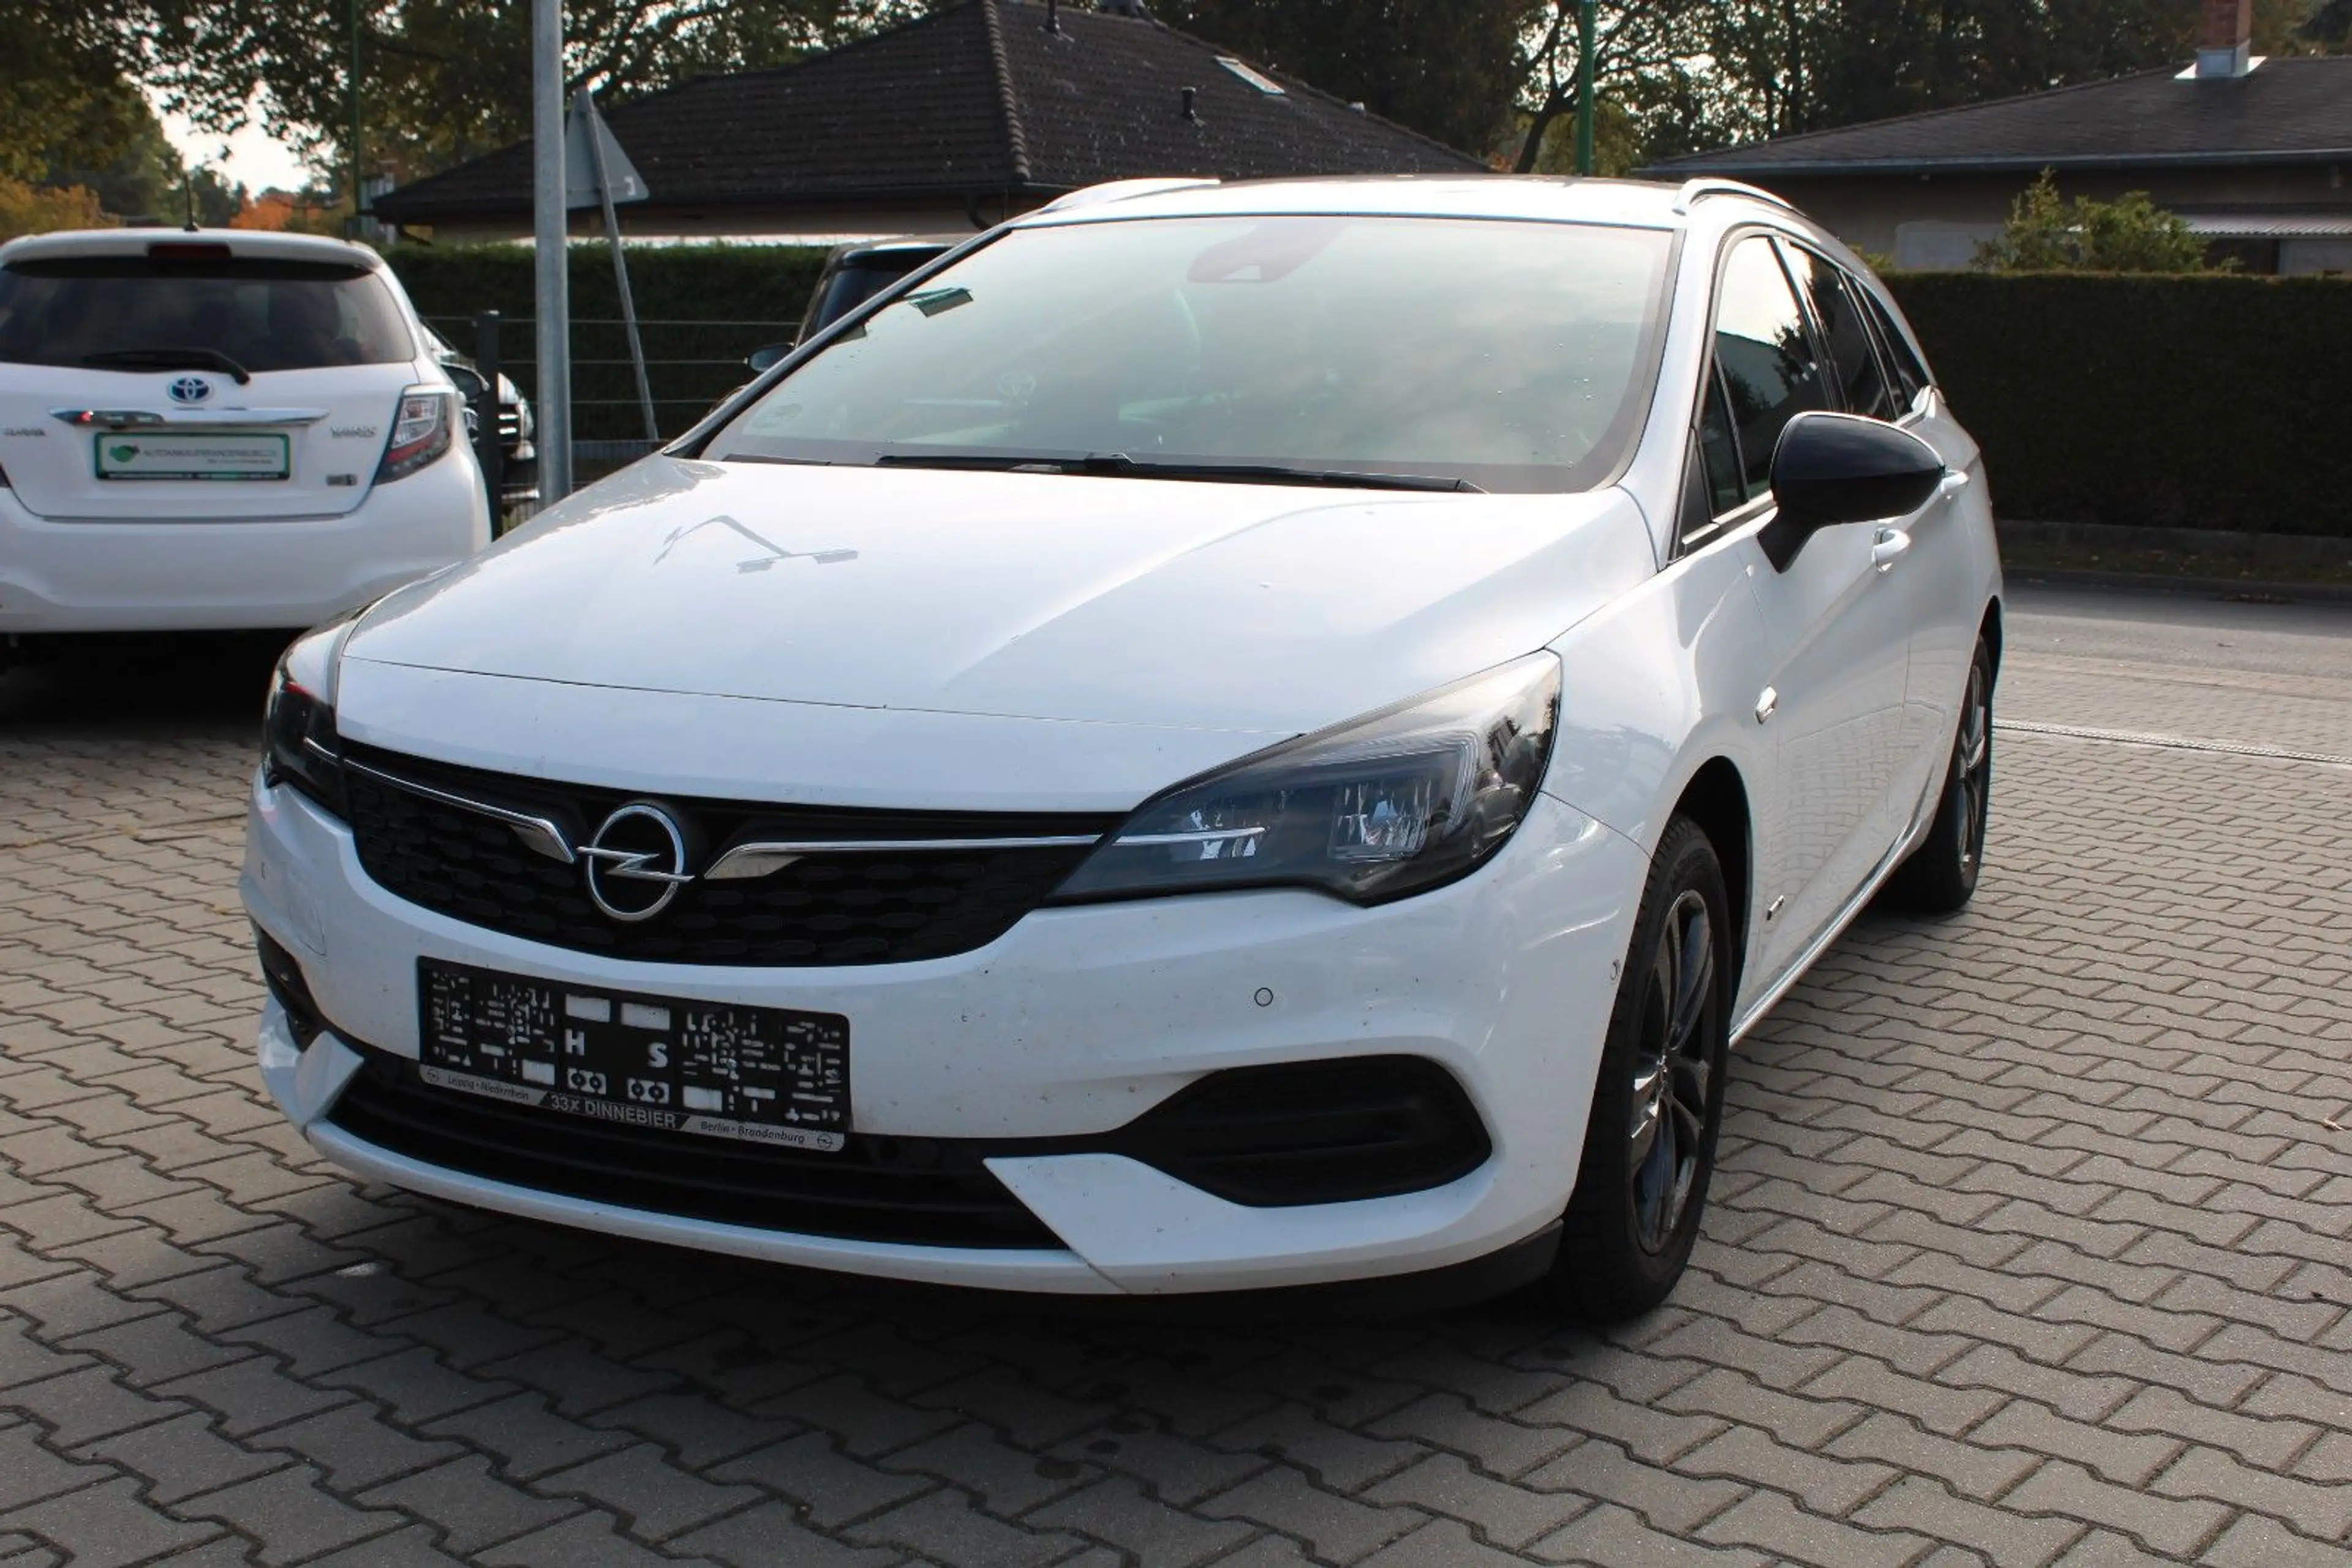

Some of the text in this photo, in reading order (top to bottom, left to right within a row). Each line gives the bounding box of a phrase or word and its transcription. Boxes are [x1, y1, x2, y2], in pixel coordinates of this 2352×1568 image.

[565, 1028, 585, 1055] H
[647, 1041, 669, 1068] S
[584, 1100, 676, 1128] DINNEBIER
[701, 1121, 805, 1144] Berlin Brandenburg
